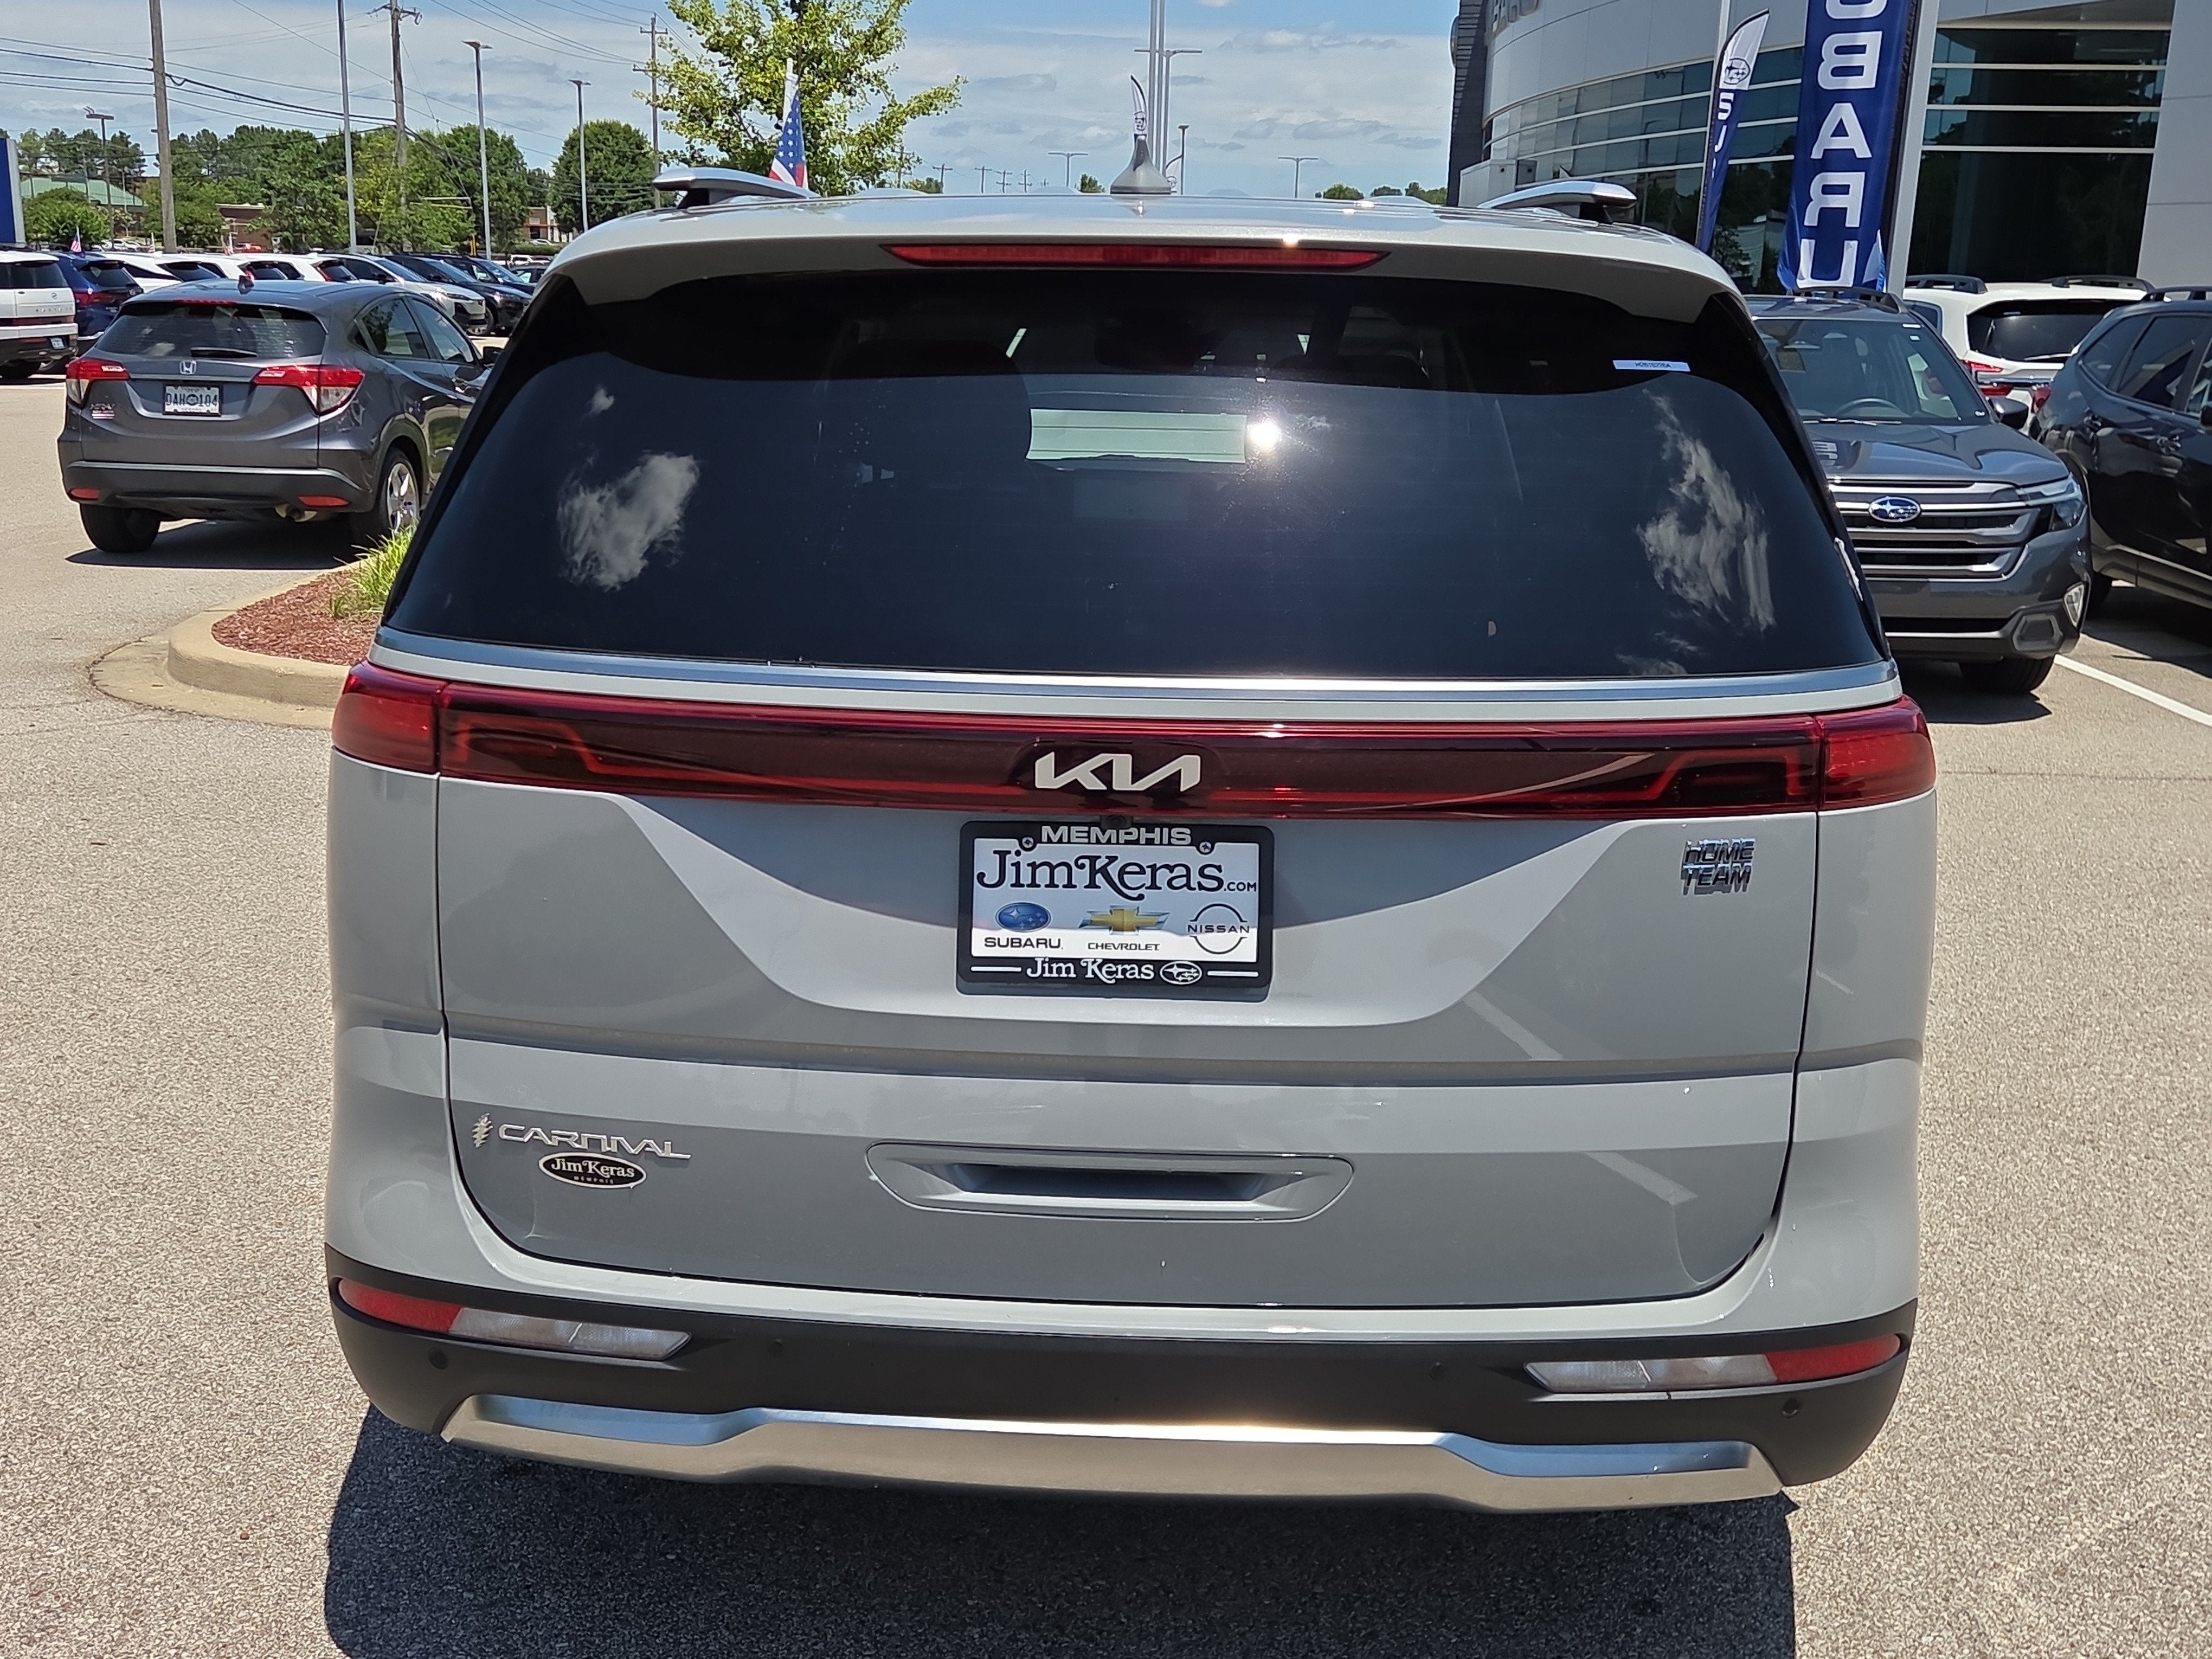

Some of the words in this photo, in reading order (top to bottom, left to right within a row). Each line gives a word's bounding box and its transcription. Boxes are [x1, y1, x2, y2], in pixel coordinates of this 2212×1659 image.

[1035, 751, 1201, 792] KIA
[1041, 826, 1192, 845] MEMPHIS
[1685, 838, 1755, 863] HOME
[1683, 863, 1752, 886] TEAM
[1187, 924, 1250, 934] NISSAN
[984, 937, 1063, 950] SUBARU
[1088, 942, 1159, 951] CHEVROLET
[1026, 957, 1077, 978] Jim
[1081, 959, 1155, 984] Keras
[498, 1123, 692, 1160] CARNIVAL
